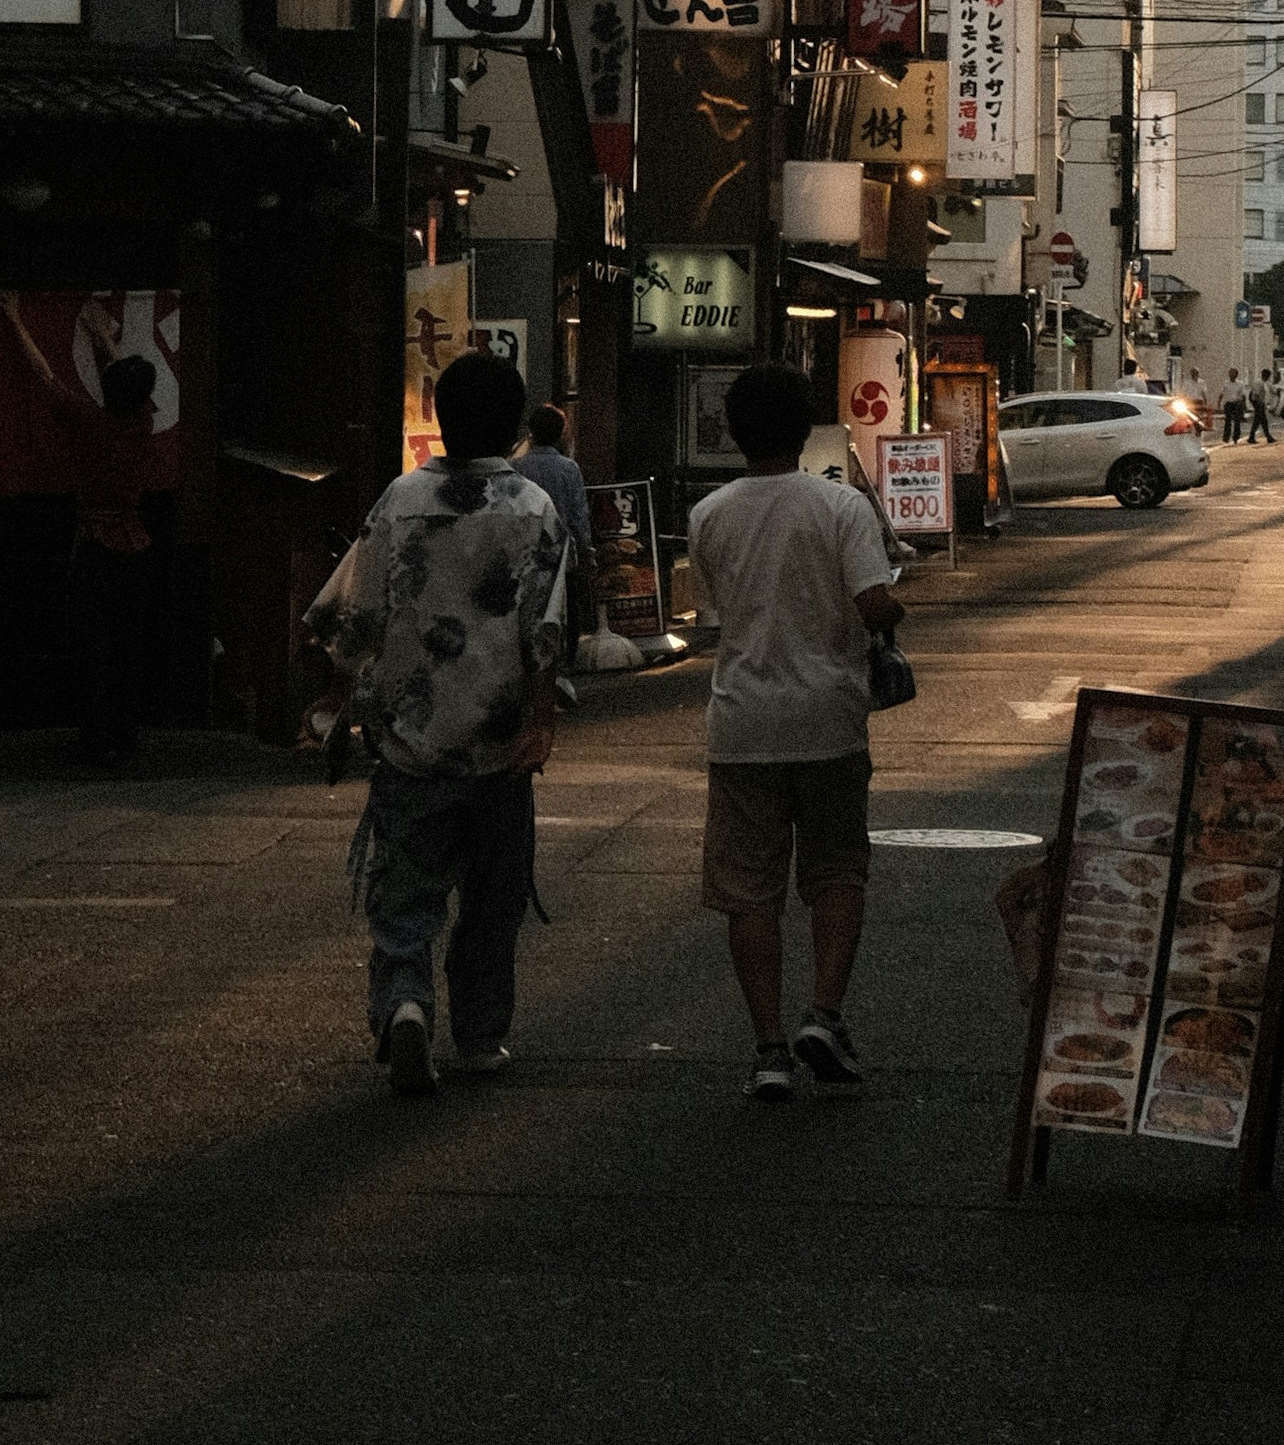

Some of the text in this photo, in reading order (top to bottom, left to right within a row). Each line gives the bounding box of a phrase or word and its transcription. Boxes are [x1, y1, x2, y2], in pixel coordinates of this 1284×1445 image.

[861, 107, 907, 152] 樹
[683, 275, 714, 298] Bar
[681, 304, 741, 328] EDDIE
[887, 495, 939, 520] 1800
